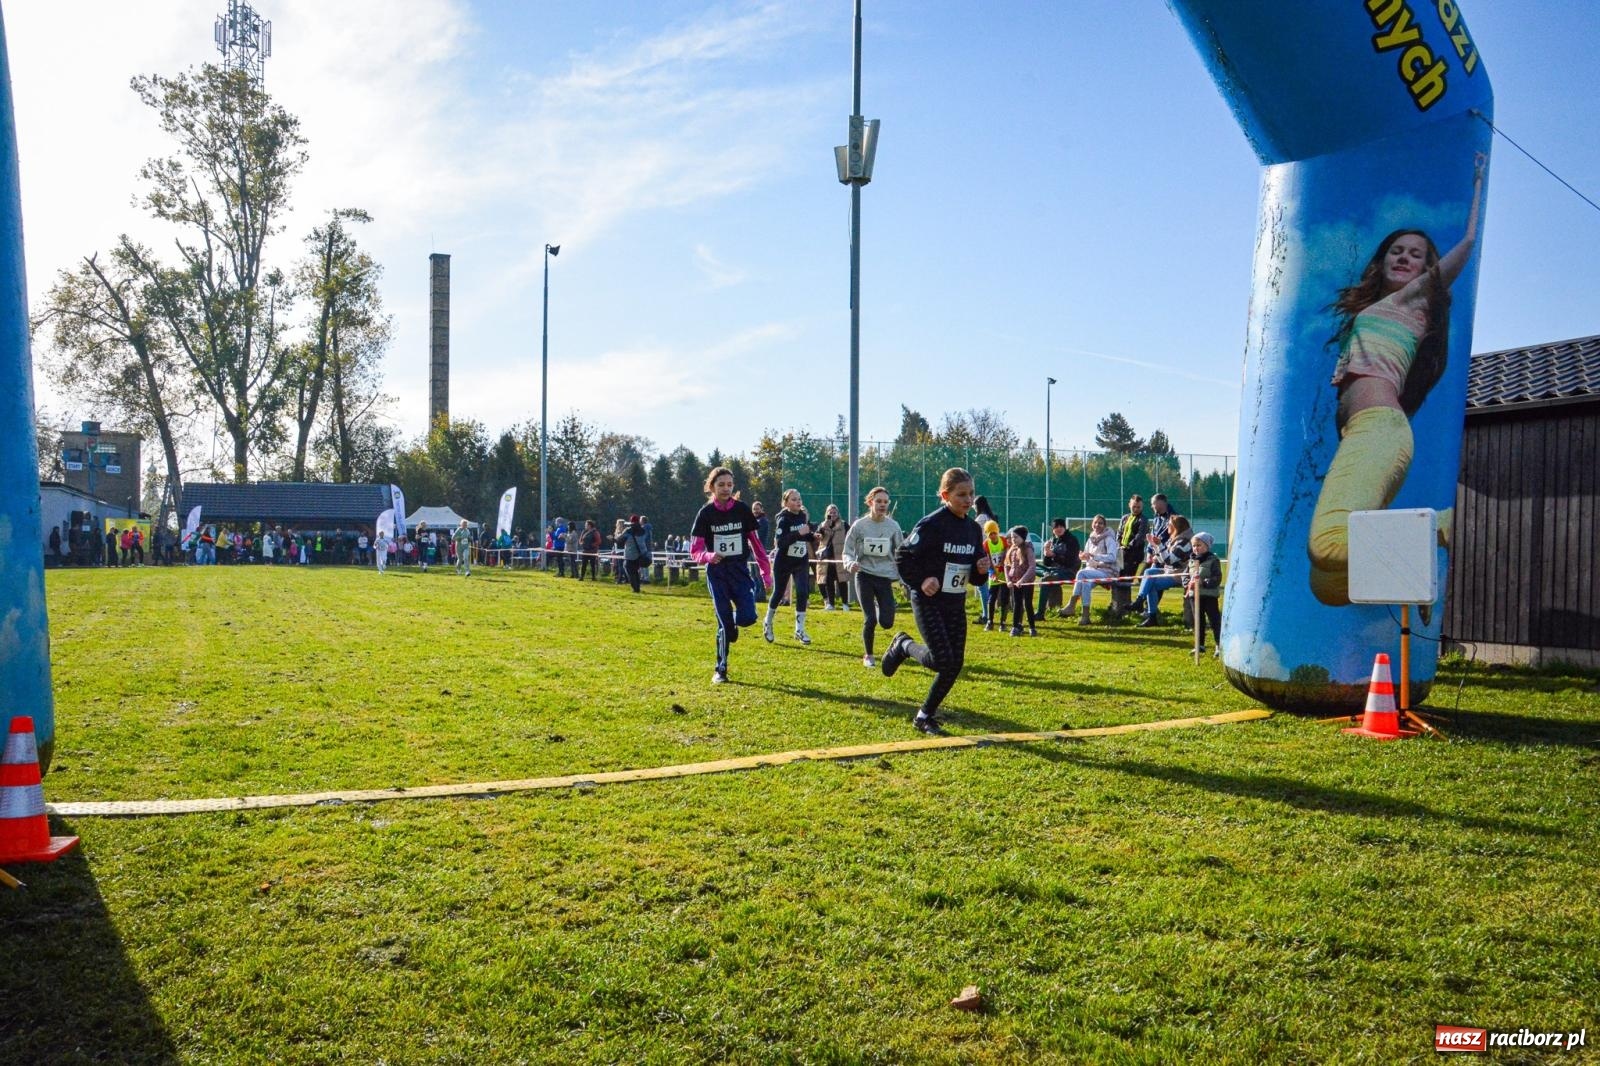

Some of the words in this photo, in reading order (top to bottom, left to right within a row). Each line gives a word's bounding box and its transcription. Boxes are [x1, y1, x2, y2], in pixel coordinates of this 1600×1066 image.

[719, 542, 736, 552] 81
[869, 544, 883, 553] 71
[951, 574, 966, 588] 64
